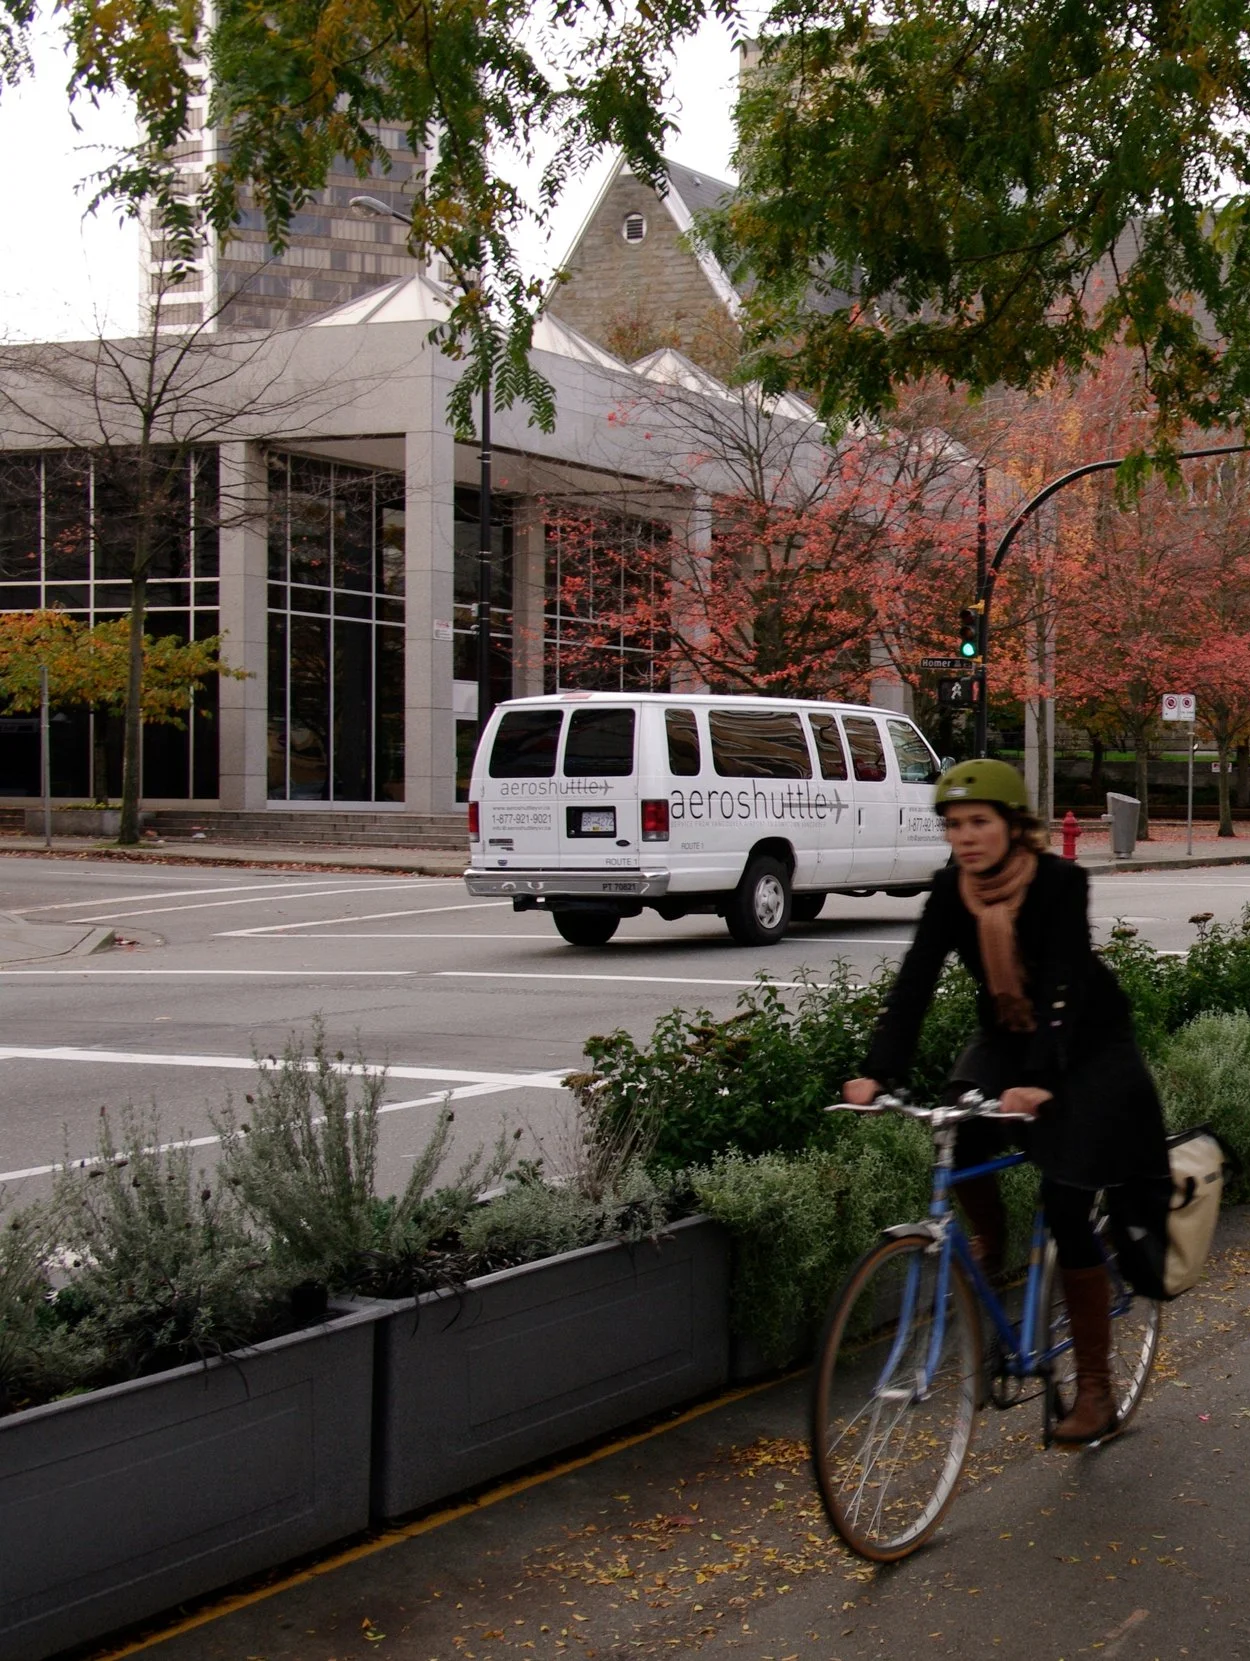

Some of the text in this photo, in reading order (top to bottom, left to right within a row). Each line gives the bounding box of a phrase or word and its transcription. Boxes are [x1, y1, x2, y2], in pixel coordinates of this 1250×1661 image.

[922, 659, 952, 667] Homer
[500, 778, 598, 796] aeroshuttle
[670, 779, 827, 819] aeroshuttle
[491, 813, 552, 824] 1-877-921-9021
[681, 842, 700, 850] ROUTE
[605, 857, 638, 866] ROUTE 1
[602, 883, 612, 891] PT
